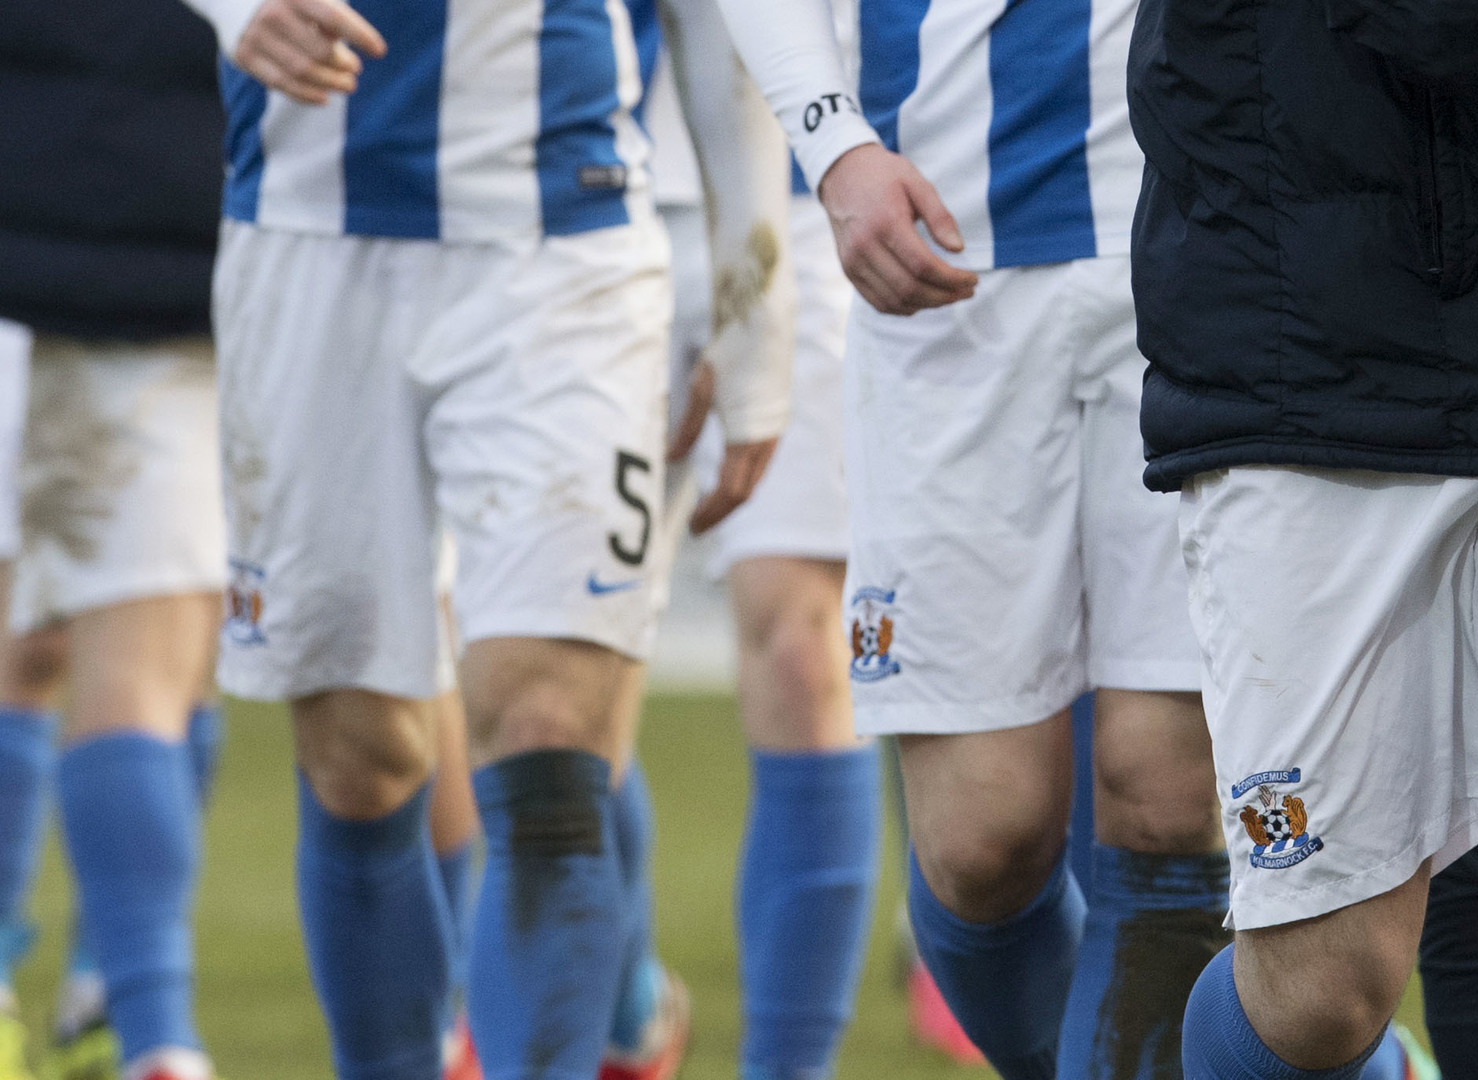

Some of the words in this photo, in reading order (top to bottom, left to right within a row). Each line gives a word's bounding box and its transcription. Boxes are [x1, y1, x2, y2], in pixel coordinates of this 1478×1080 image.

[610, 450, 650, 566] 5
[1237, 771, 1289, 793] CONFIDEMUS
[1252, 850, 1306, 868] KILMARNOCK
